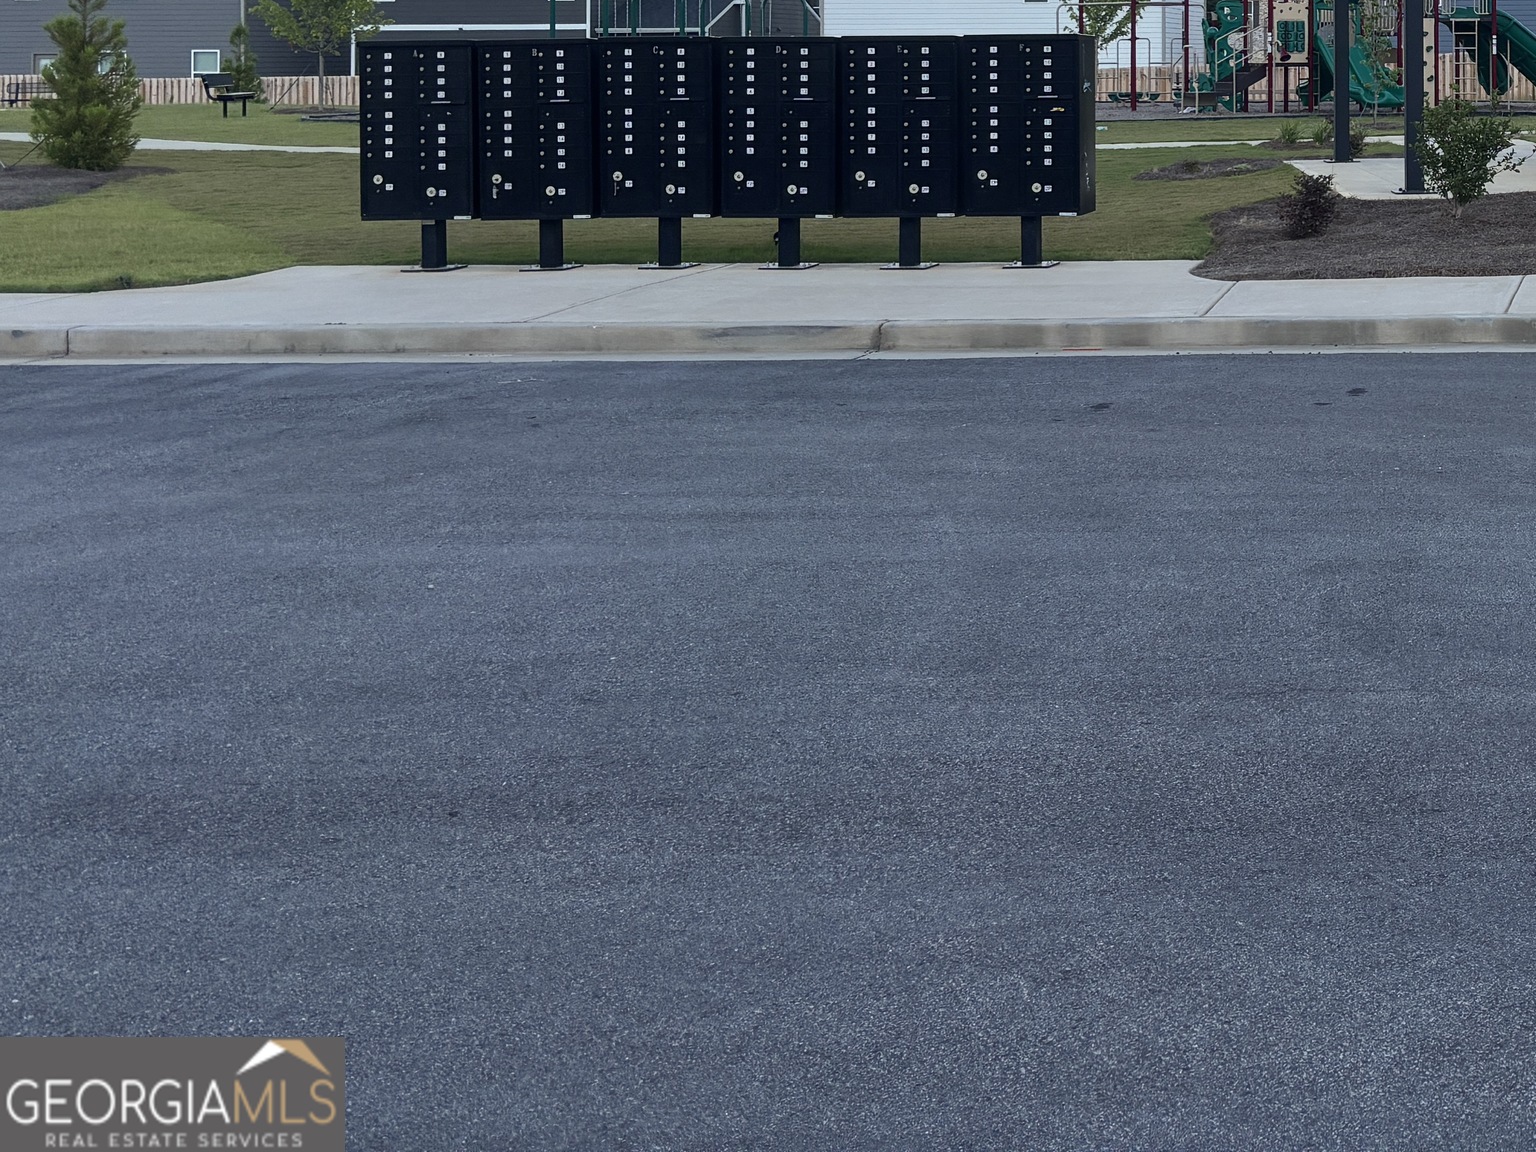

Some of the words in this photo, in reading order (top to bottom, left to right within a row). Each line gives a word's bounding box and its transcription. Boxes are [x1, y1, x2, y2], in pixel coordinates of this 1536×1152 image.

[532, 48, 538, 57] B
[653, 46, 659, 54] C
[775, 45, 782, 54] D
